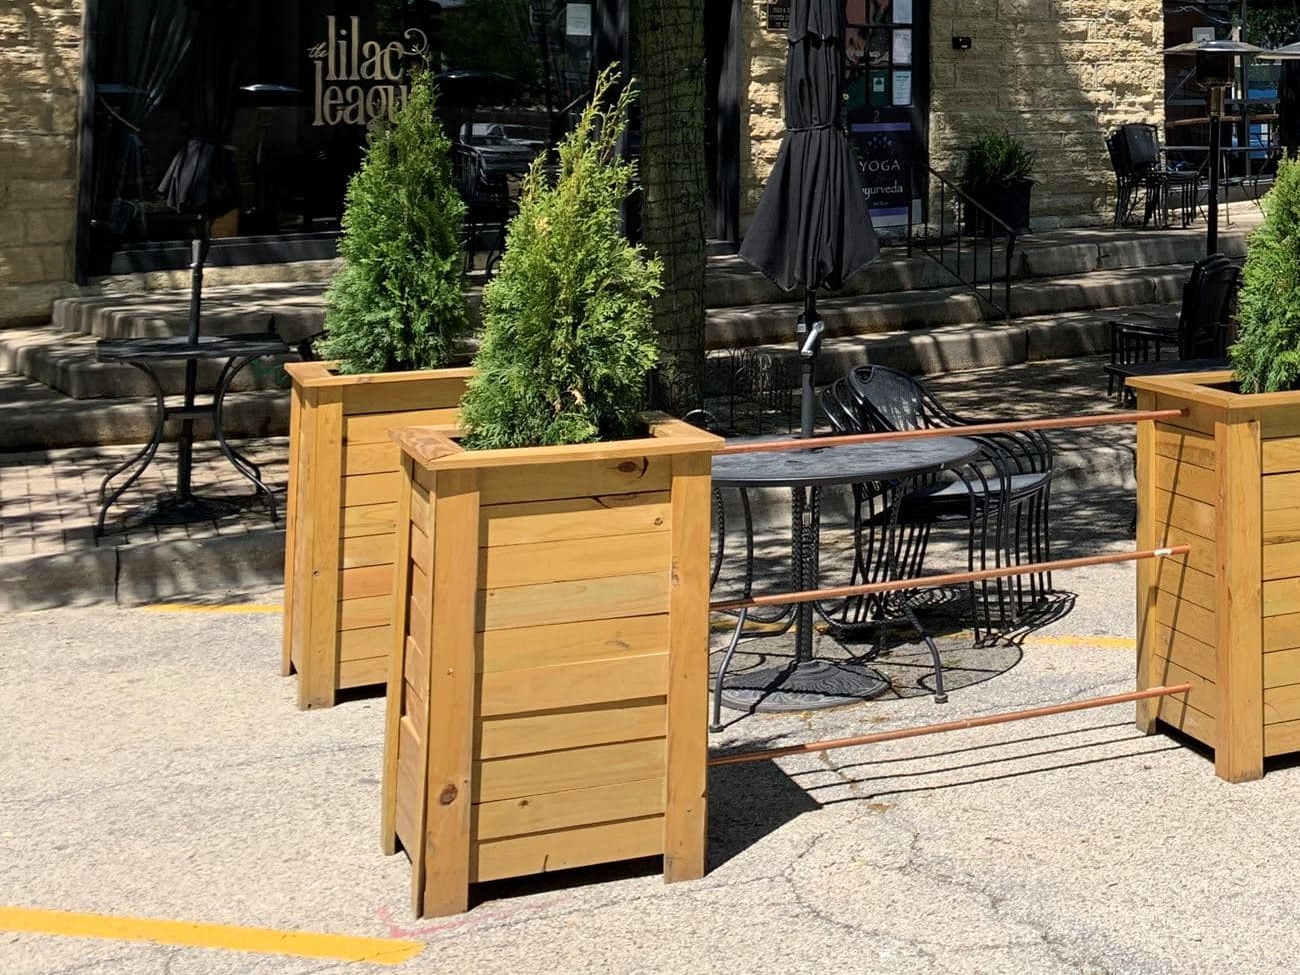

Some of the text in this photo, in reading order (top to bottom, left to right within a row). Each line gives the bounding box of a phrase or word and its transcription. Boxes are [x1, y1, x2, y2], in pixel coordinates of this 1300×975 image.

[307, 42, 328, 57] the
[326, 15, 404, 80] lilac
[312, 60, 408, 139] leagu
[859, 160, 901, 172] YOGA
